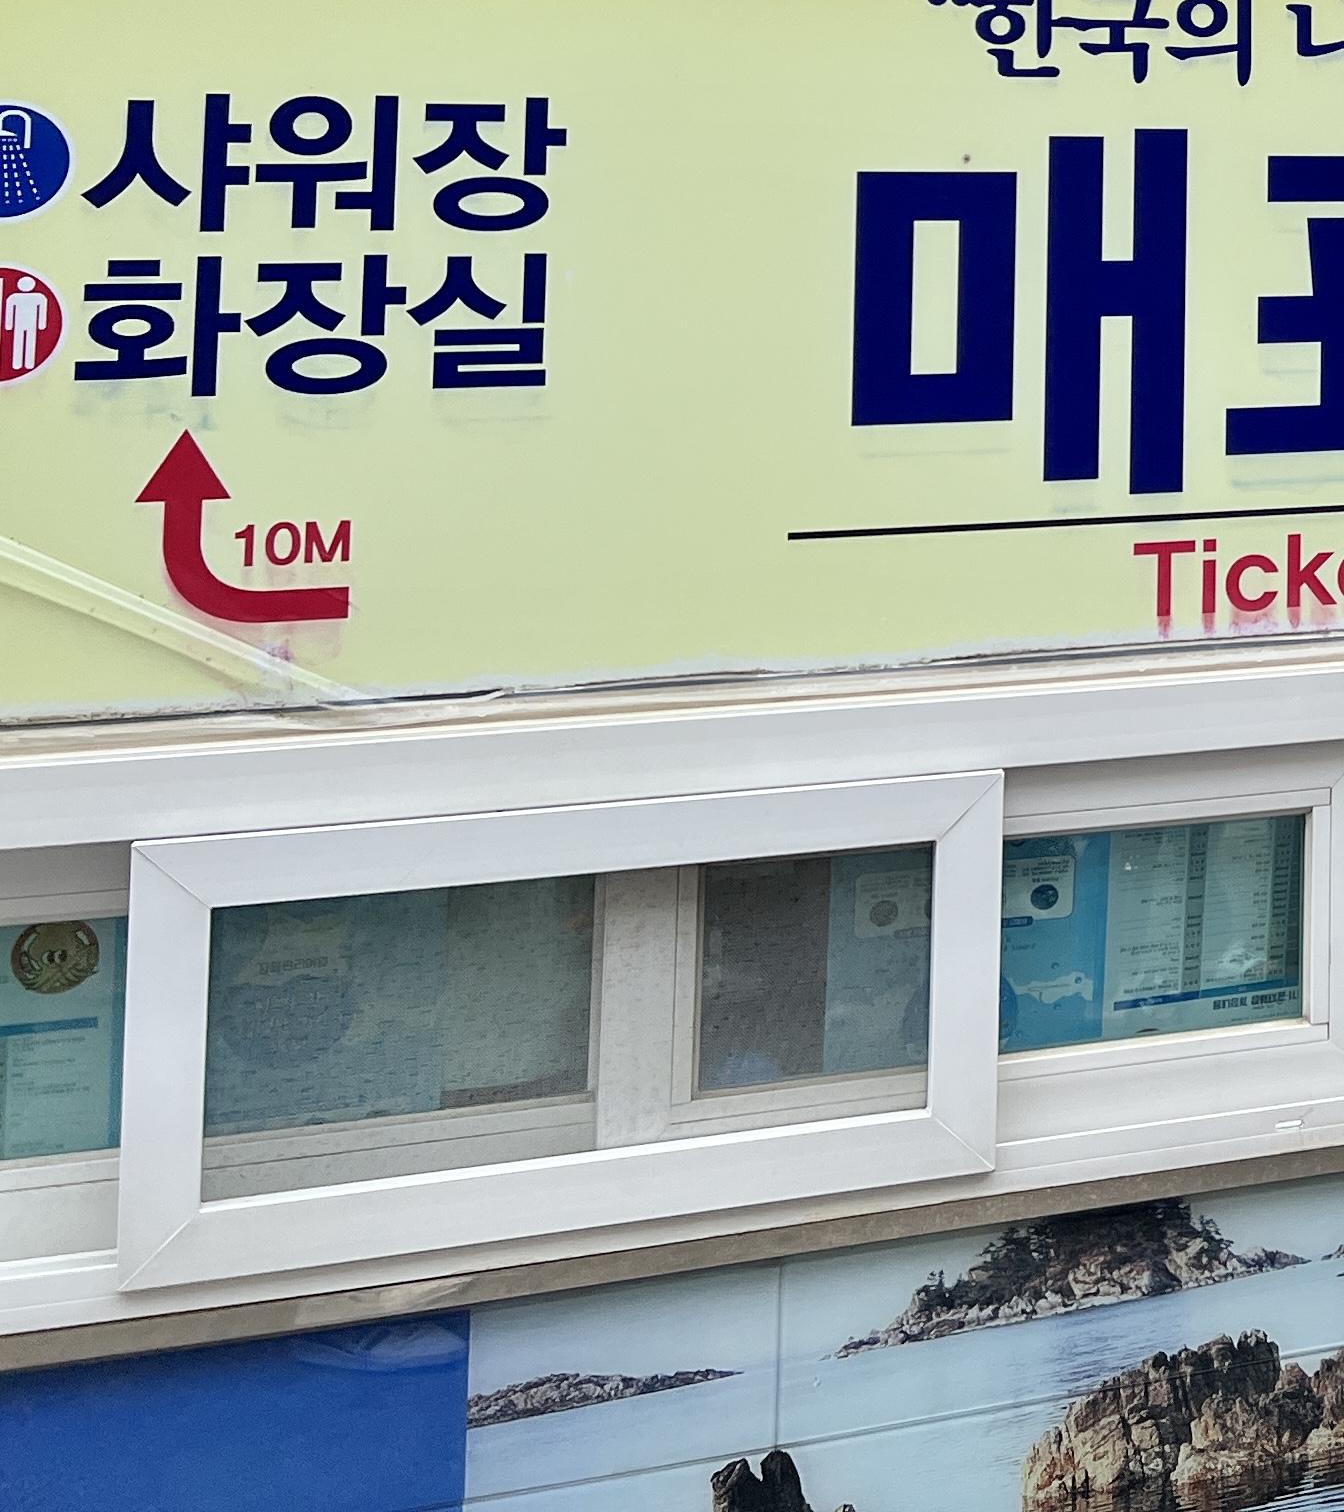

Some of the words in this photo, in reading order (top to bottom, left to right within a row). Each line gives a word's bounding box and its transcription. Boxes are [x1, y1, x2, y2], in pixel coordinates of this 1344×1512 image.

[82, 93, 567, 234] 샤워장
[72, 253, 548, 398] 화장실
[233, 519, 352, 568] 10M
